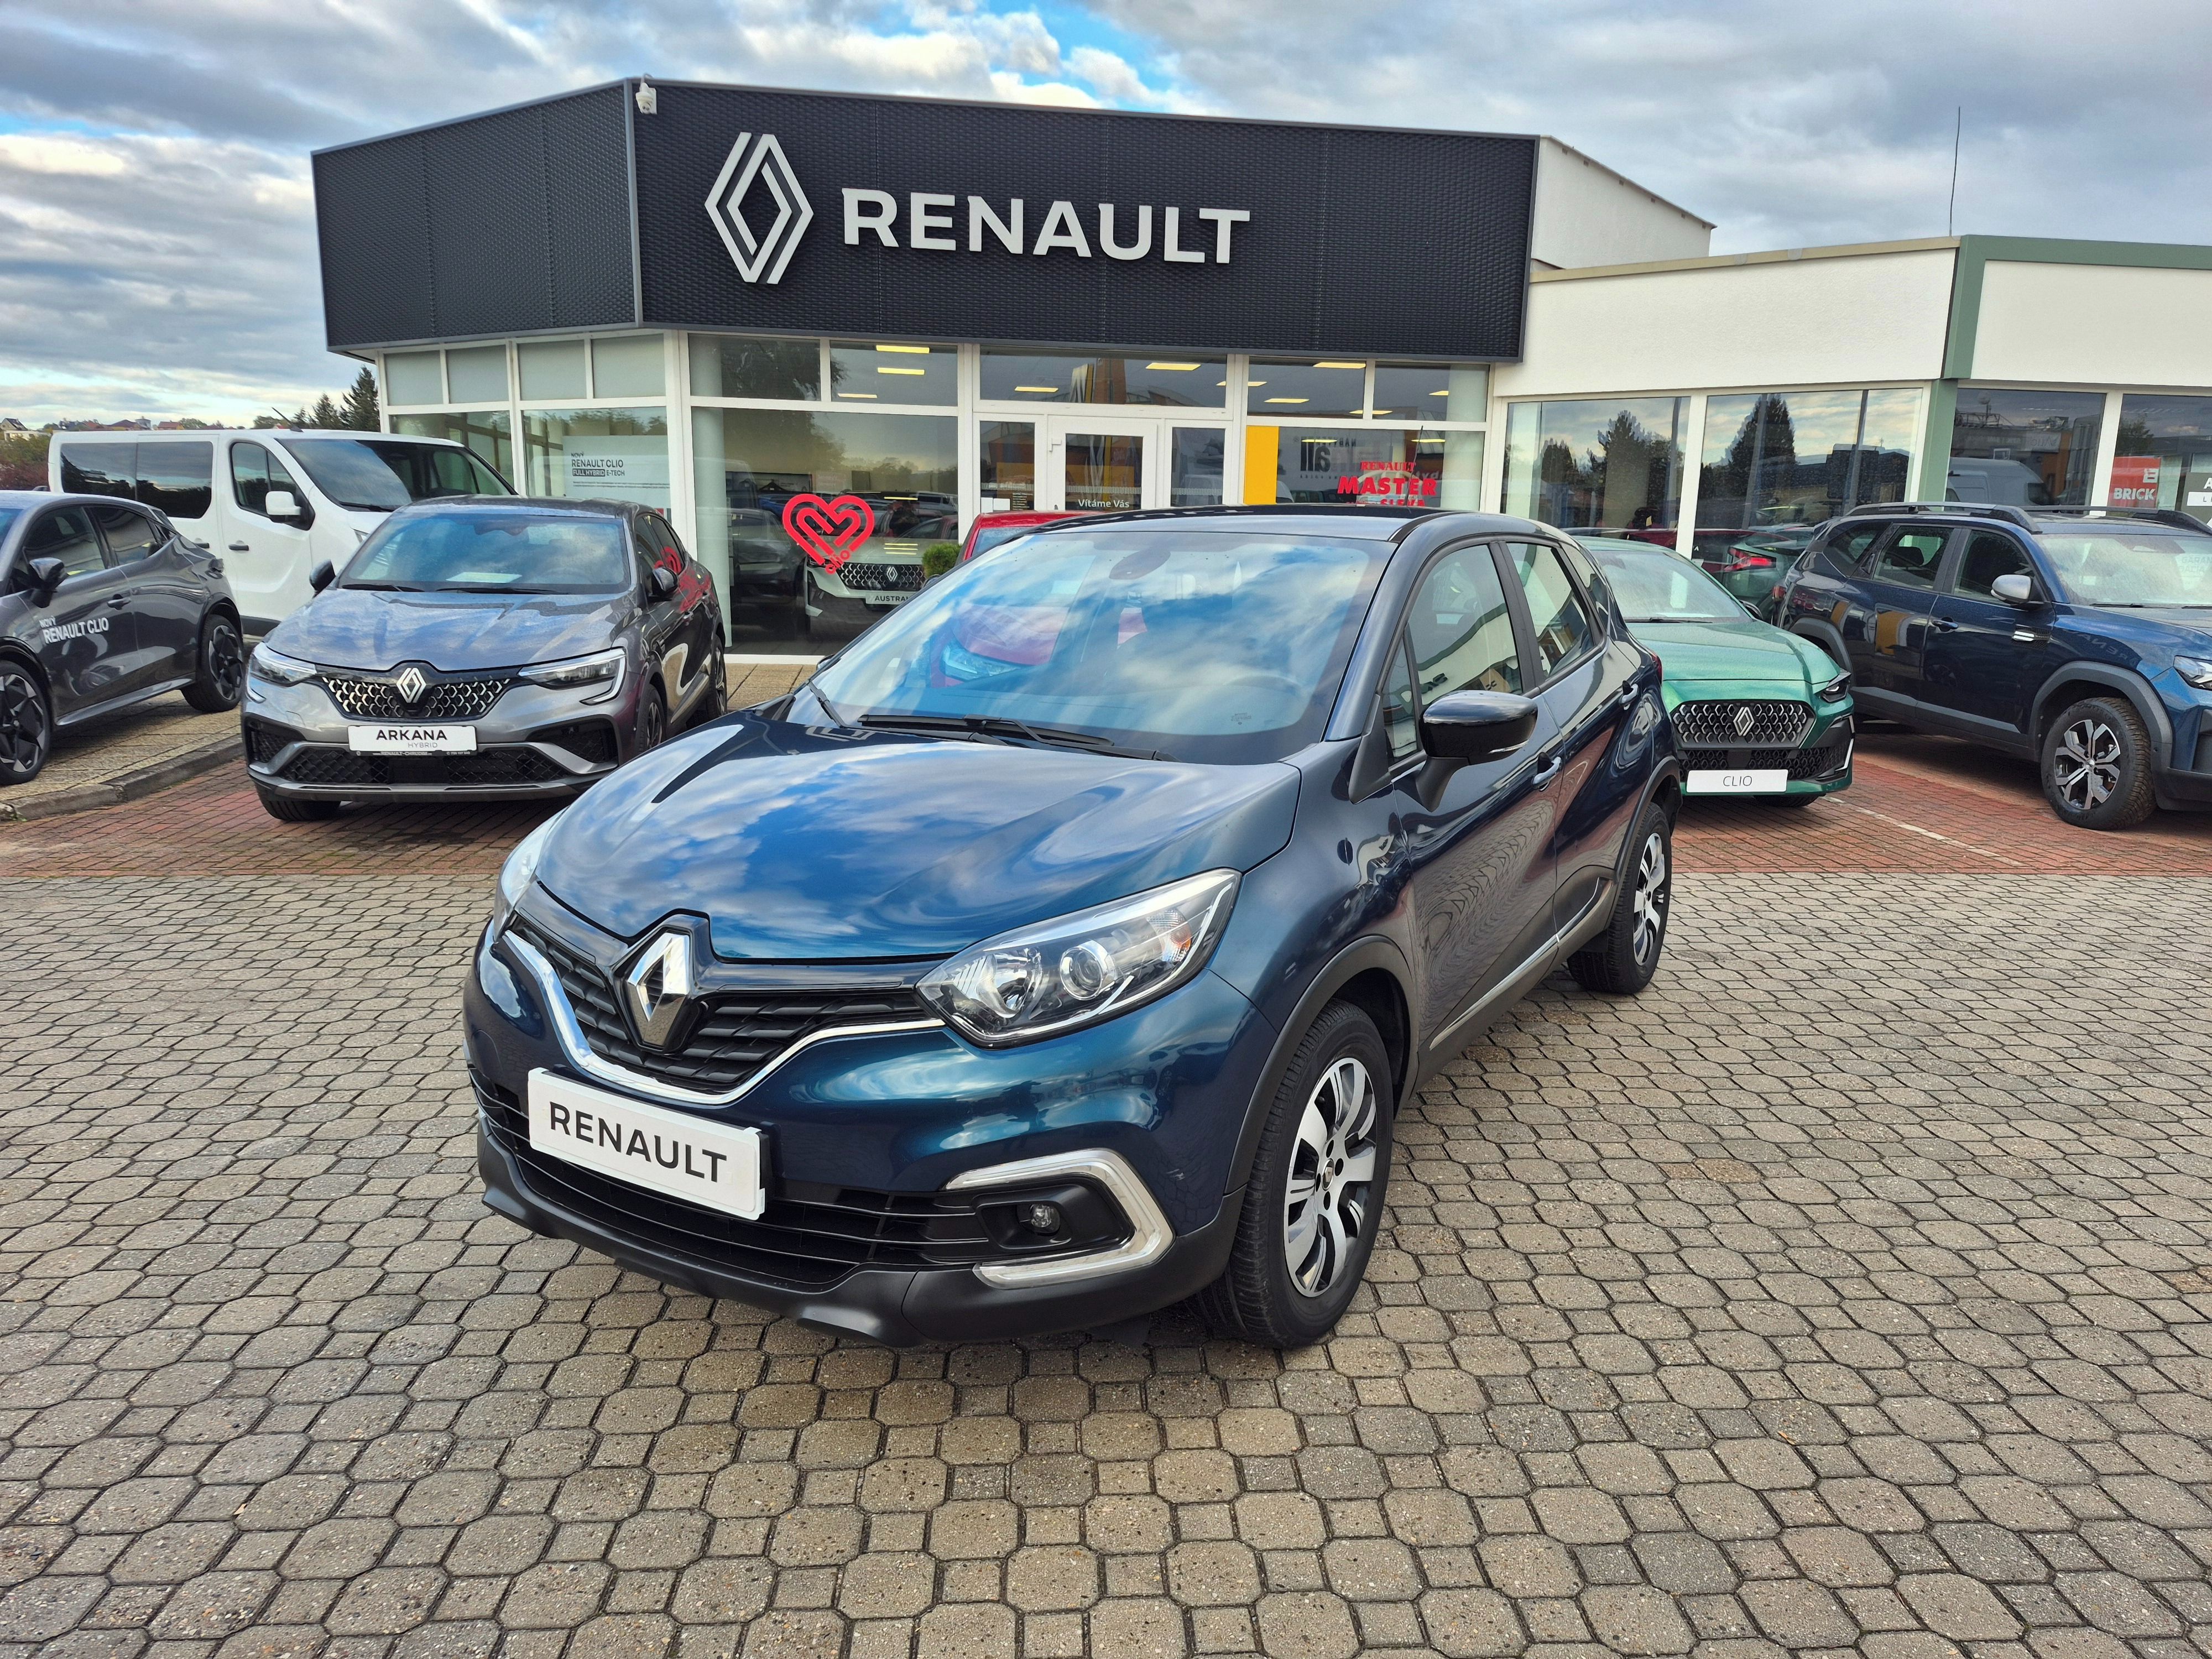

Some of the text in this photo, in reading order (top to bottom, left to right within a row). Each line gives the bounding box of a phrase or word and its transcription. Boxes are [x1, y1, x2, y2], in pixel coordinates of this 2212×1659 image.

[841, 187, 1250, 264] RENAULT
[572, 459, 624, 468] RENAULT CLIO
[1360, 461, 1416, 471] RENAULT
[1337, 475, 1437, 496] MASTER
[2113, 488, 2156, 500] BRICK
[1078, 499, 1130, 508] Vítáme Vás
[42, 617, 109, 644] RENAULT CLIO
[376, 729, 447, 740] ARKANA
[1723, 775, 1752, 787] CLIO
[549, 1101, 728, 1183] RENAULT
